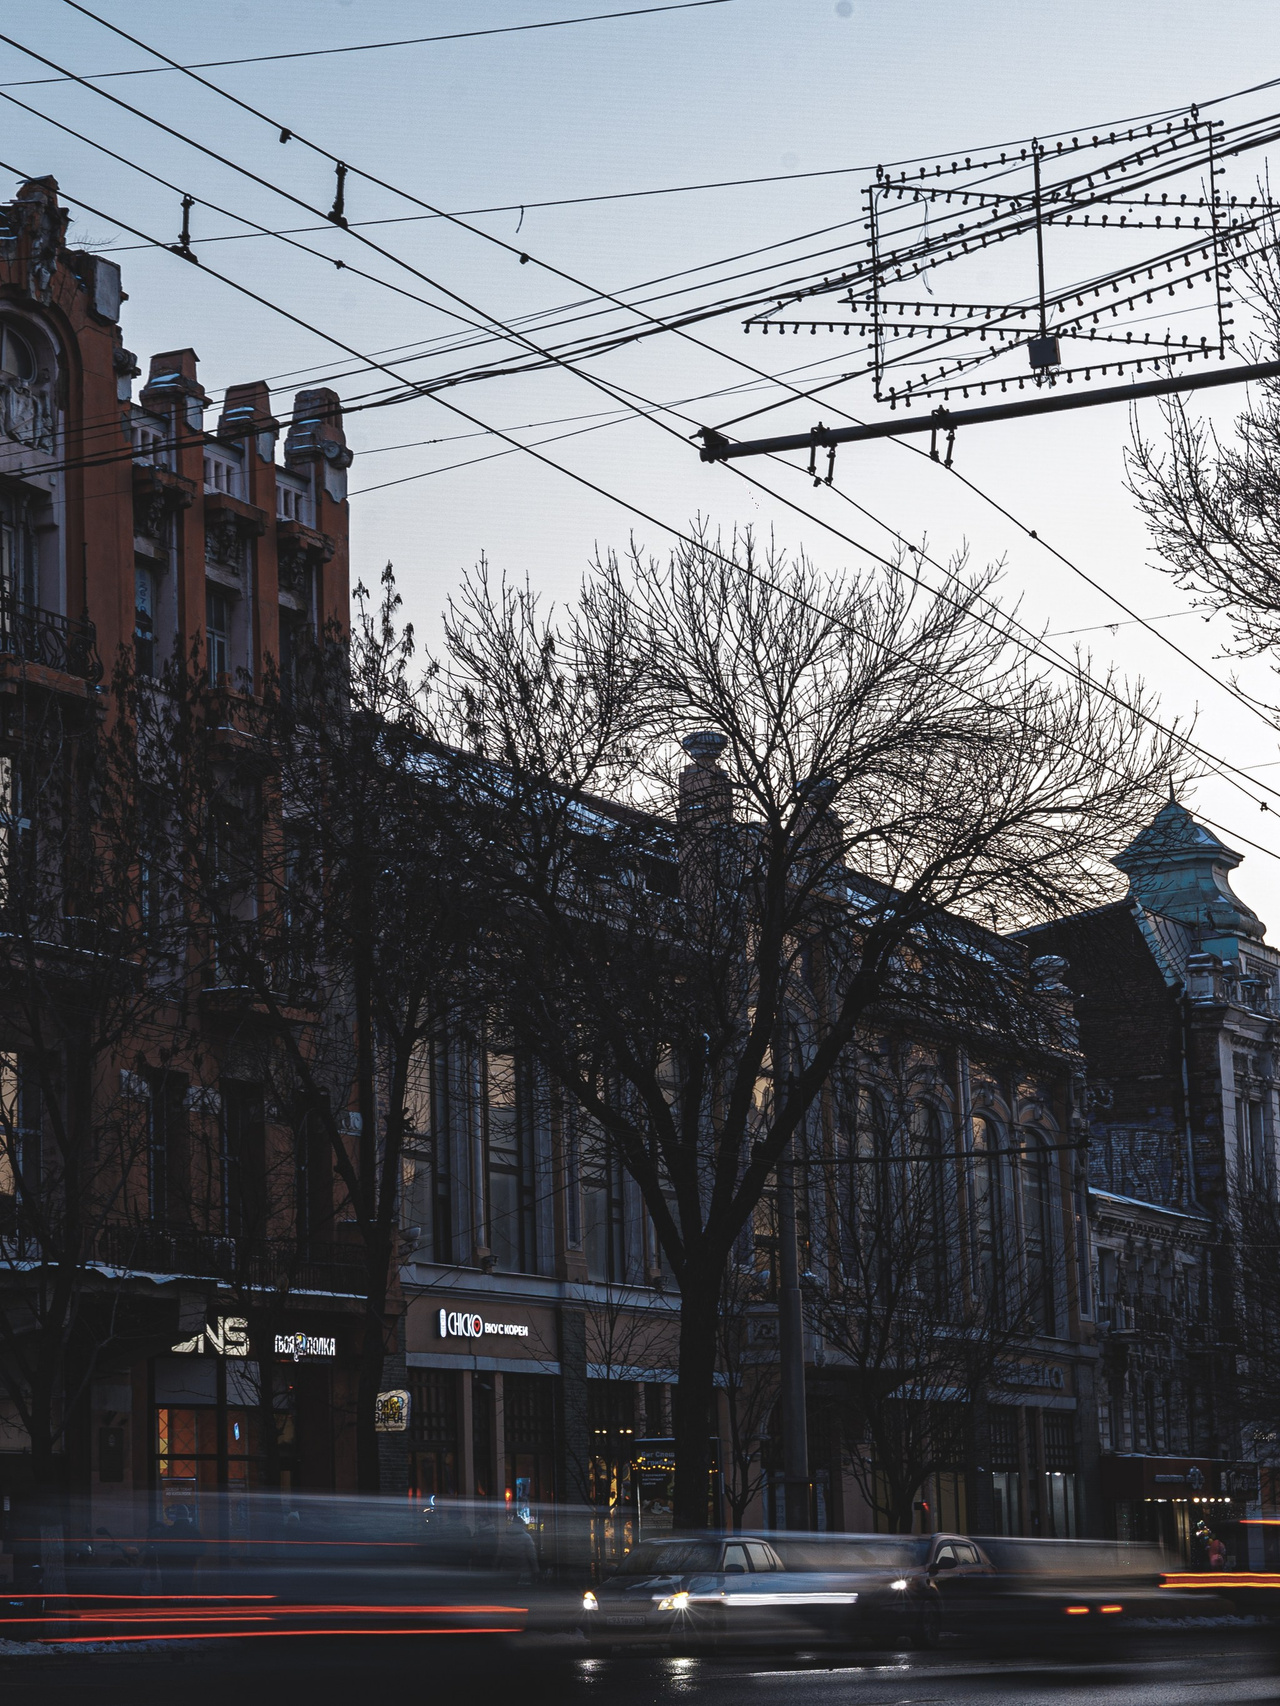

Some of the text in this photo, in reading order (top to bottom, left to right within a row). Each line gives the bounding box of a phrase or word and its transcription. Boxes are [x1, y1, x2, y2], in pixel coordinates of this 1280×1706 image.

[448, 1312, 529, 1337] CHICKO ВКУС КОРЕИ
[307, 1337, 336, 1356] ПОЛКА
